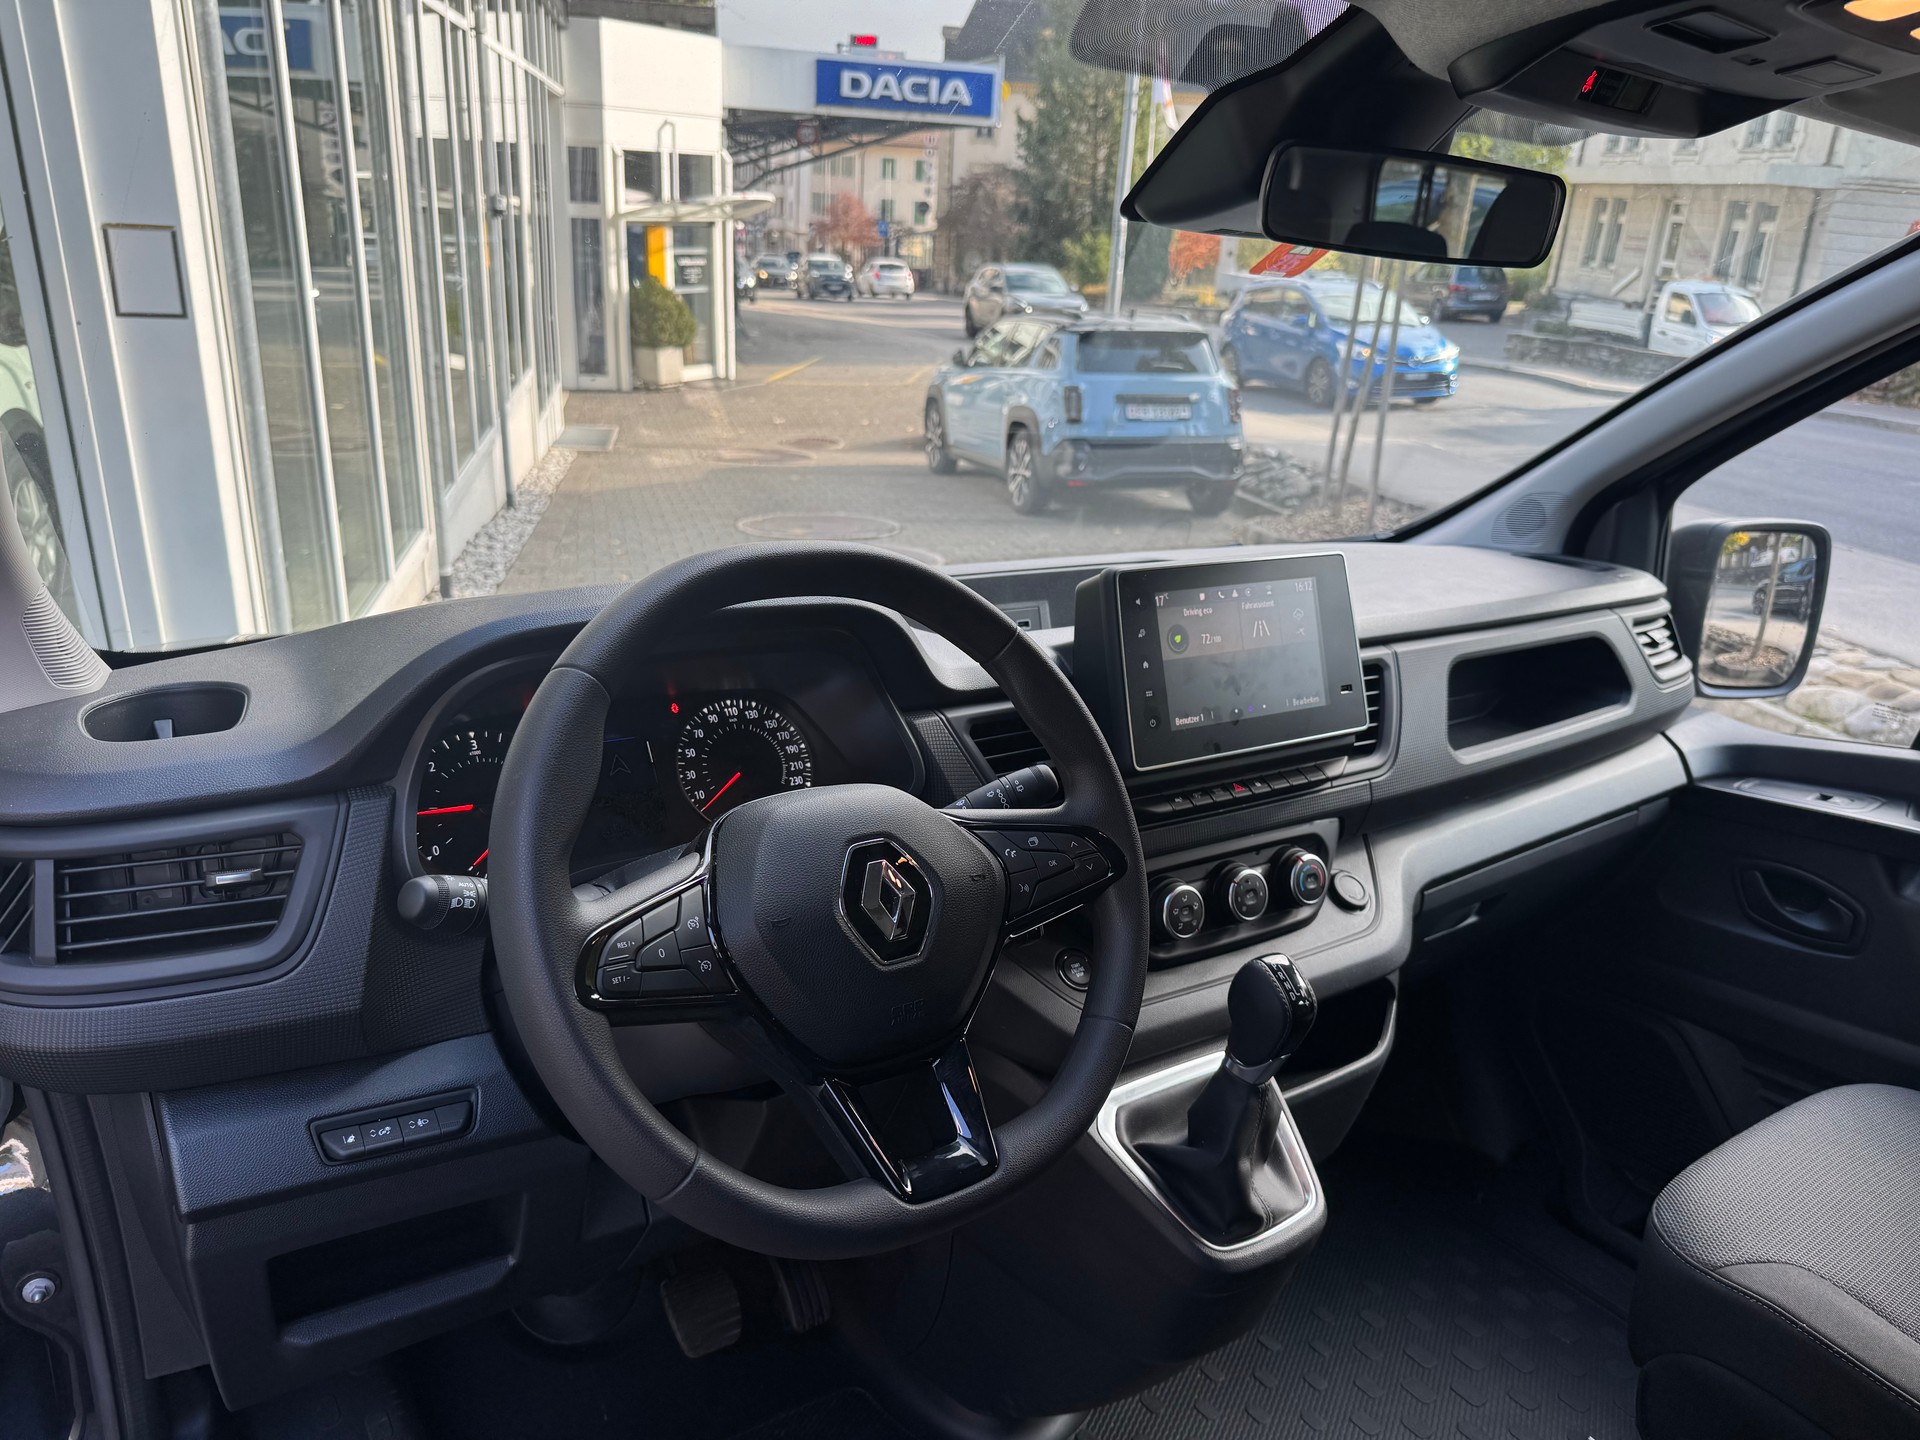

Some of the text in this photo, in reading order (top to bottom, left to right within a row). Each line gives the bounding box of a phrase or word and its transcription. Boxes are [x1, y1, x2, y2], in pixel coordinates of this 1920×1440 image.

[840, 70, 973, 107] DACIA
[1295, 580, 1313, 592] 16:12
[1183, 607, 1213, 617] Driving eco
[724, 707, 738, 716] 110
[745, 710, 758, 719] 130
[707, 714, 719, 724] 90
[764, 719, 778, 729] 150
[1175, 715, 1200, 726] Benutzer
[693, 729, 704, 739] 70
[776, 731, 790, 741] 170
[470, 739, 478, 750] 3
[785, 744, 799, 755] 190
[685, 748, 696, 758] 50
[428, 762, 436, 773] 2
[789, 761, 804, 771] 210
[685, 770, 696, 780] 30
[789, 776, 804, 786] 230
[694, 790, 705, 800] 10
[432, 845, 440, 856] 0
[1277, 971, 1286, 980] R
[1283, 980, 1292, 990] N
[1289, 991, 1296, 1000] D
